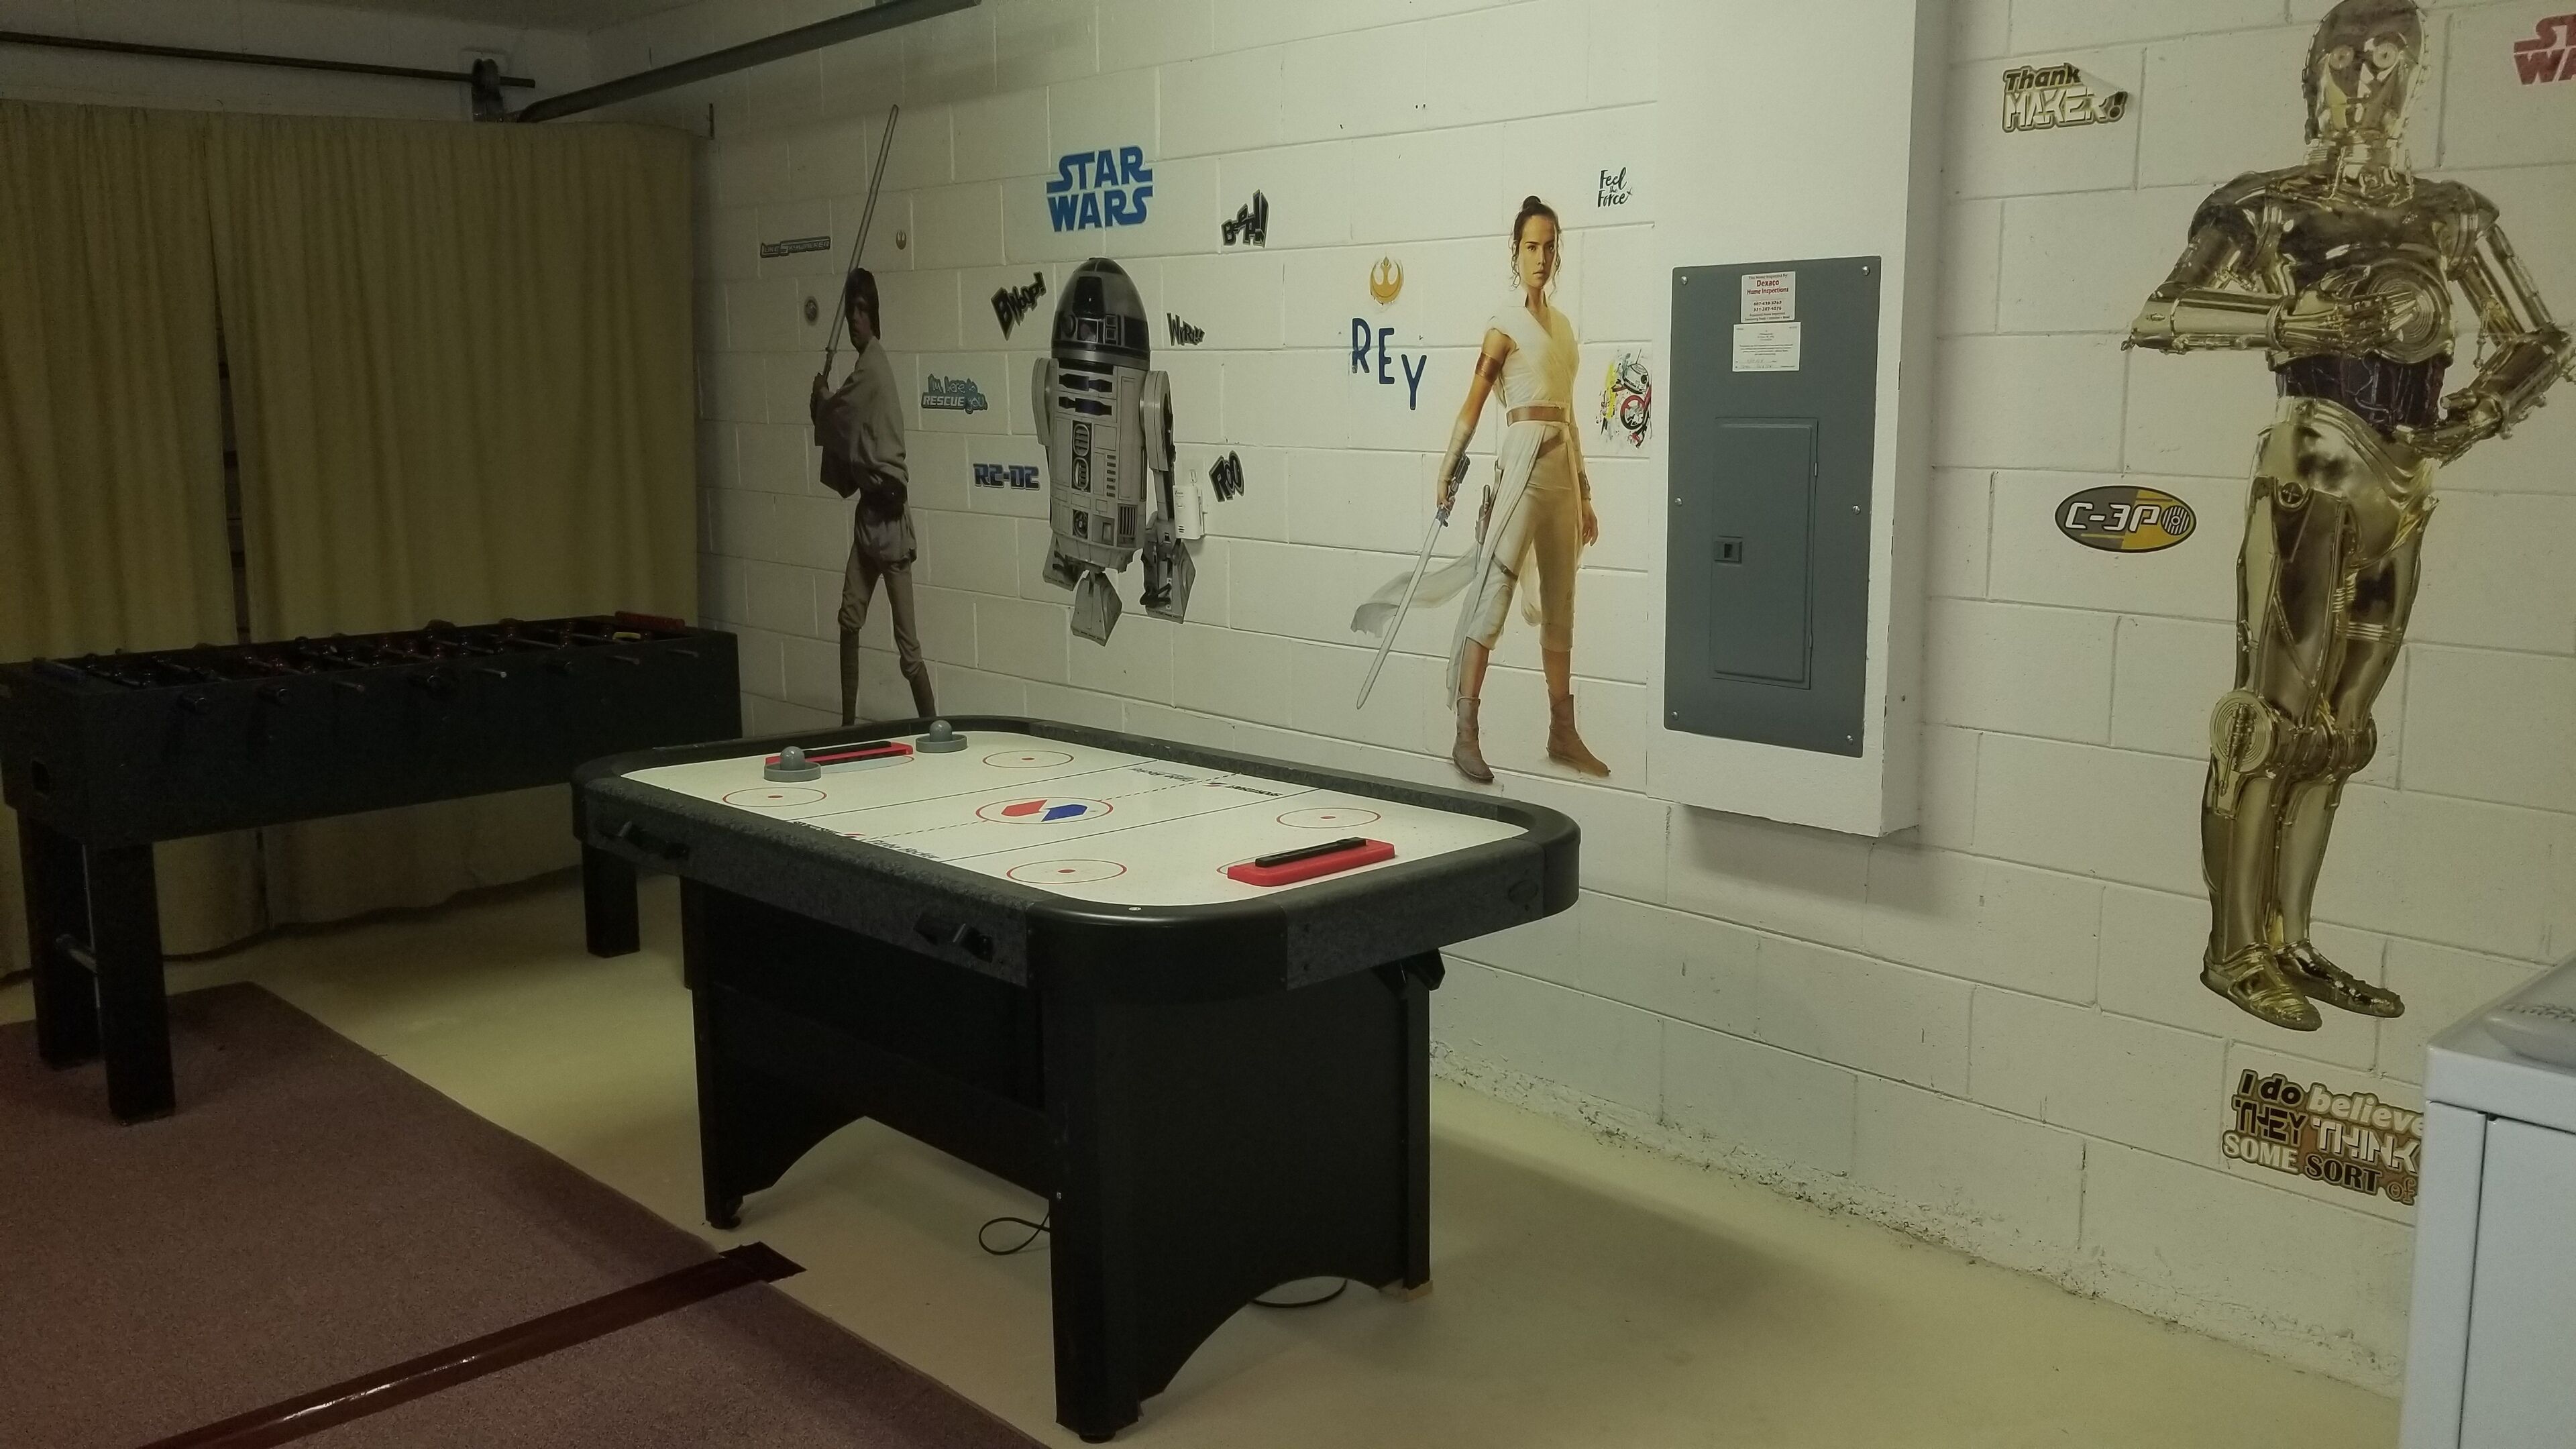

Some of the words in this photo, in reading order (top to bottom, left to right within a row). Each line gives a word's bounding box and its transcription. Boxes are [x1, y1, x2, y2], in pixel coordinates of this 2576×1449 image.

[2006, 67, 2081, 91] Thank
[1046, 146, 1152, 193] STAR
[1600, 167, 1627, 190] Feel
[1047, 185, 1153, 232] WARS
[1598, 190, 1629, 207] Force
[1352, 317, 1427, 411] REY
[922, 395, 965, 407] RESCUE
[973, 464, 1040, 490] R2-D2
[2241, 1073, 2255, 1095] I
[2260, 1077, 2302, 1106] do
[2308, 1085, 2423, 1136] believe
[2235, 1099, 2307, 1146] THEY
[2312, 1118, 2421, 1175] THINK
[2222, 1132, 2300, 1174] SOME
[2305, 1154, 2381, 1193] SORT
[2387, 1177, 2416, 1203] of
